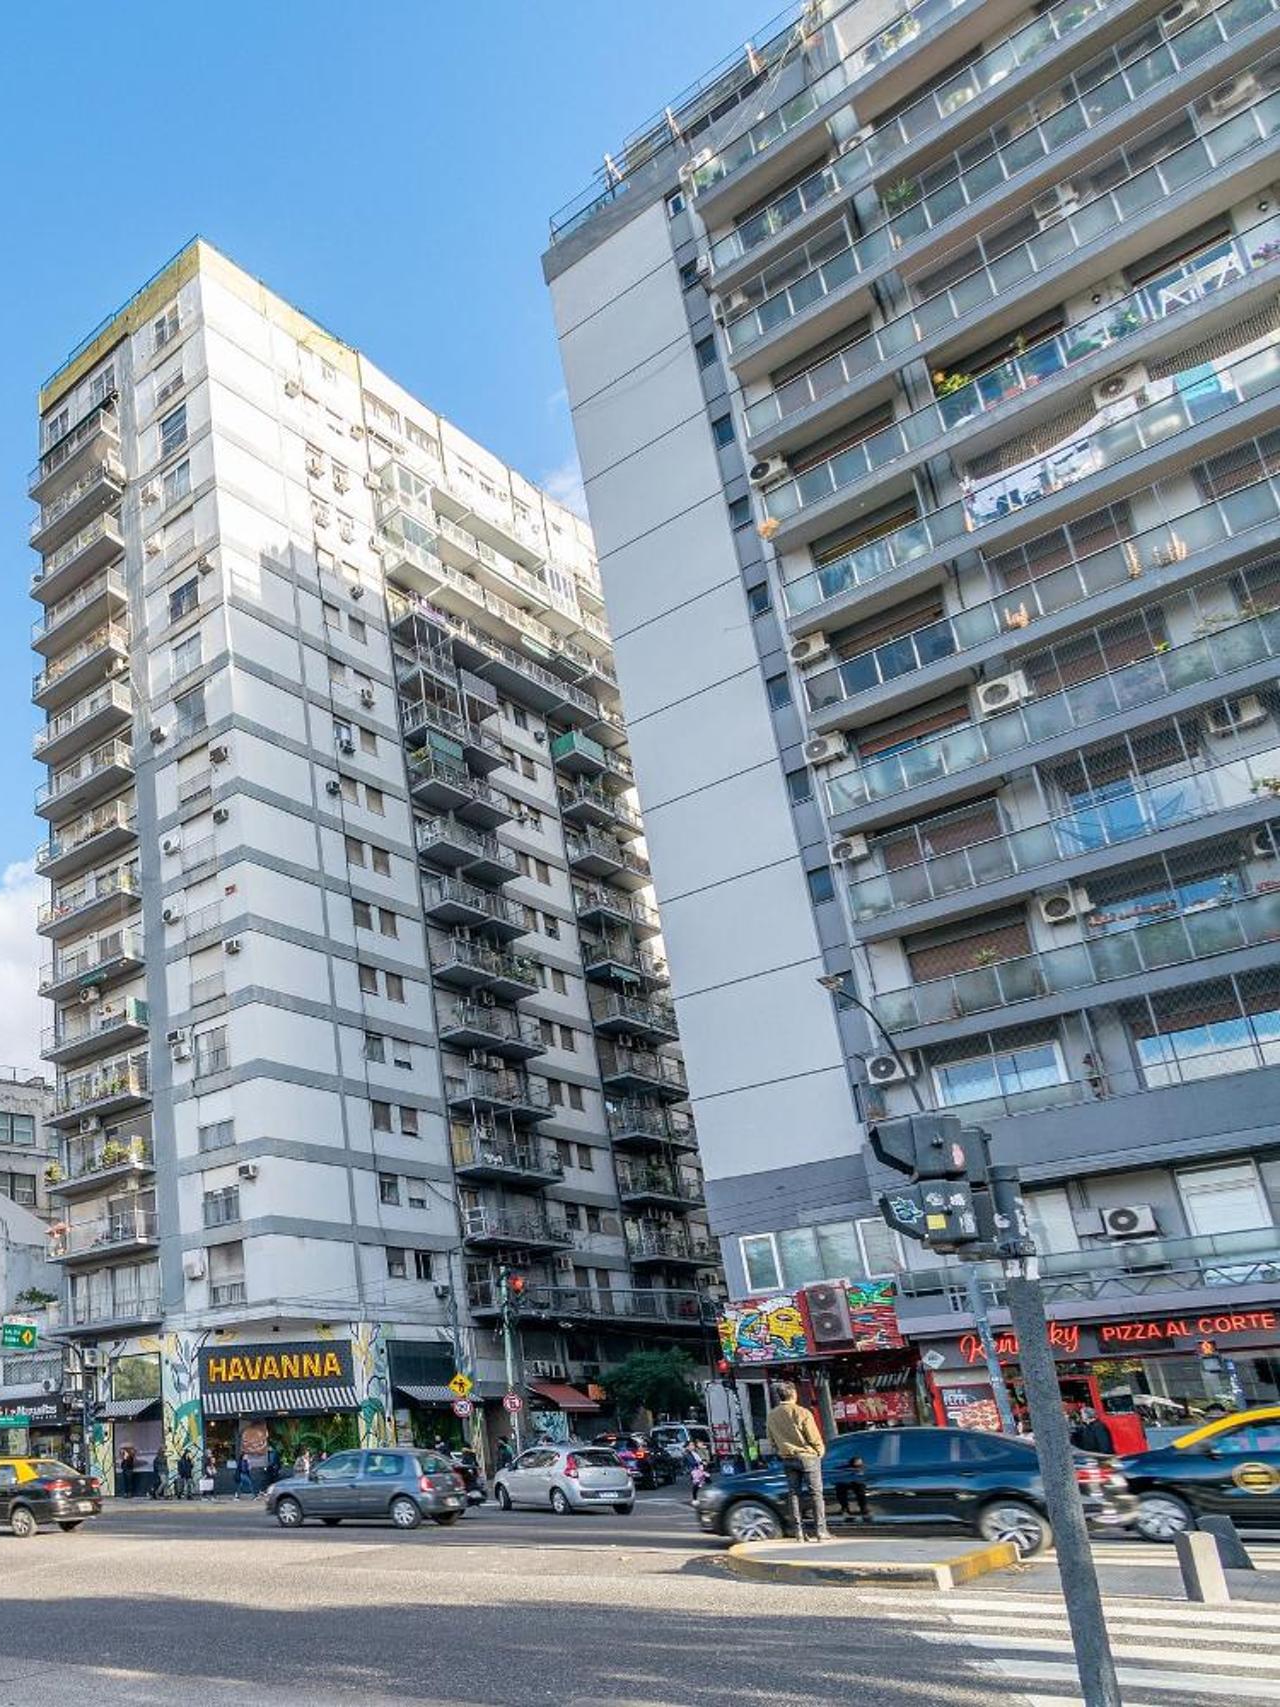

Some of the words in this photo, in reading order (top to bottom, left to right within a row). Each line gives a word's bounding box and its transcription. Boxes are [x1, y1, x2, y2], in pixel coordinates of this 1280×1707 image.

[1101, 1323, 1161, 1342] PIZZA
[1166, 1320, 1193, 1338] AL
[1197, 1312, 1277, 1335] CORTE
[207, 1351, 342, 1383] HAVANNA
